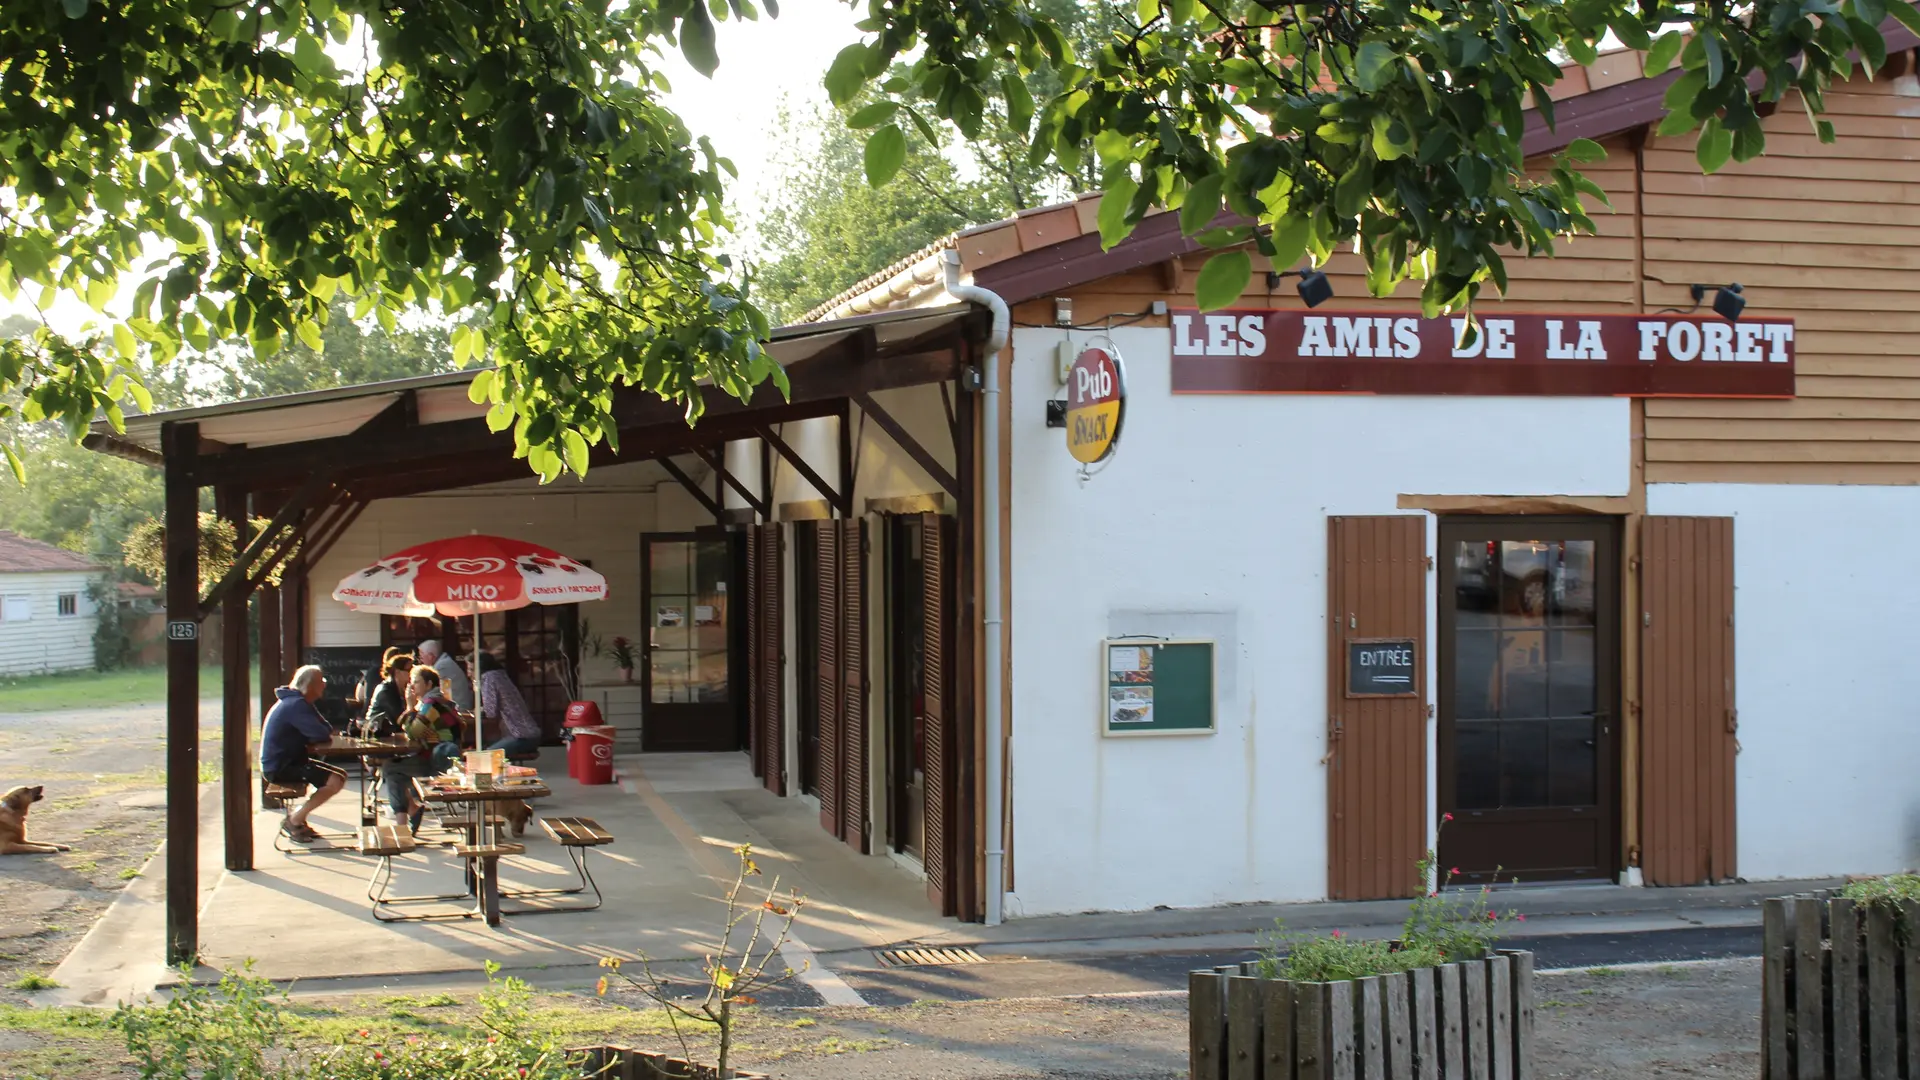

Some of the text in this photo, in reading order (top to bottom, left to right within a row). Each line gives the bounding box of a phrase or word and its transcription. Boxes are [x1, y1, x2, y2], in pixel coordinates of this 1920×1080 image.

[1173, 315, 1794, 363] LES AMIS DE LA FORET
[1076, 360, 1112, 403] Pub
[1074, 413, 1109, 446] SNACK
[447, 584, 499, 600] MIKO
[172, 624, 193, 637] 125
